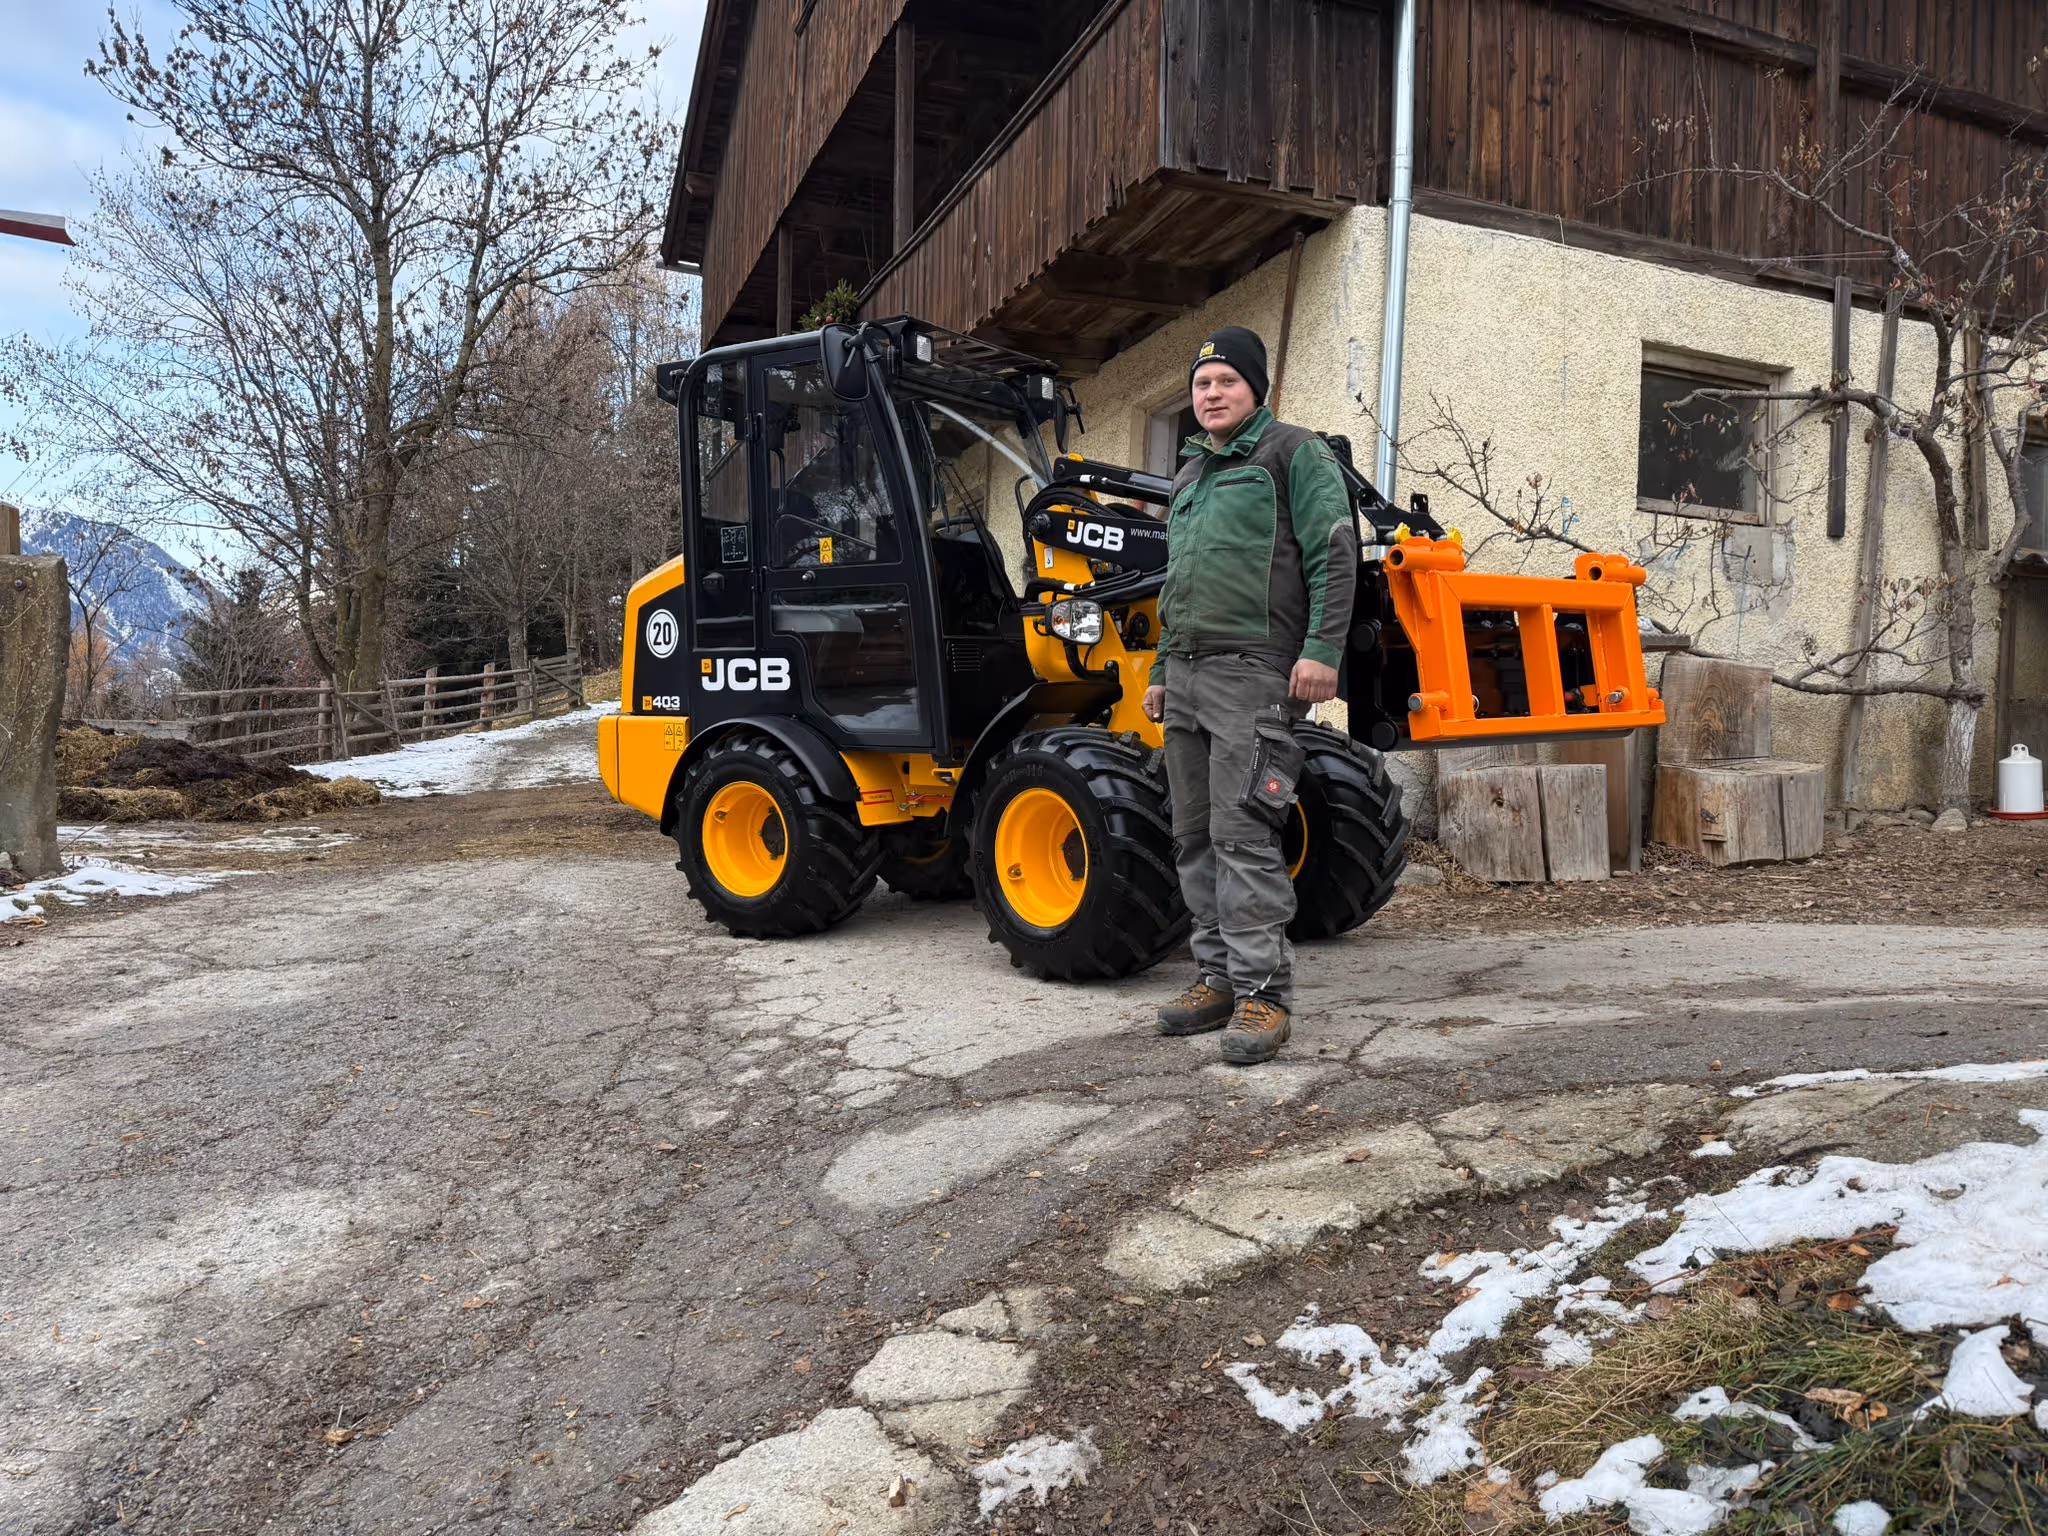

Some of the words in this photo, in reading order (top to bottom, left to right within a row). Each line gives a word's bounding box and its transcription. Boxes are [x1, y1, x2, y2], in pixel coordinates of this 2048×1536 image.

[1066, 521, 1125, 551] JCB
[653, 622, 671, 645] 20
[701, 657, 791, 691] JCB
[653, 696, 680, 708] 403
